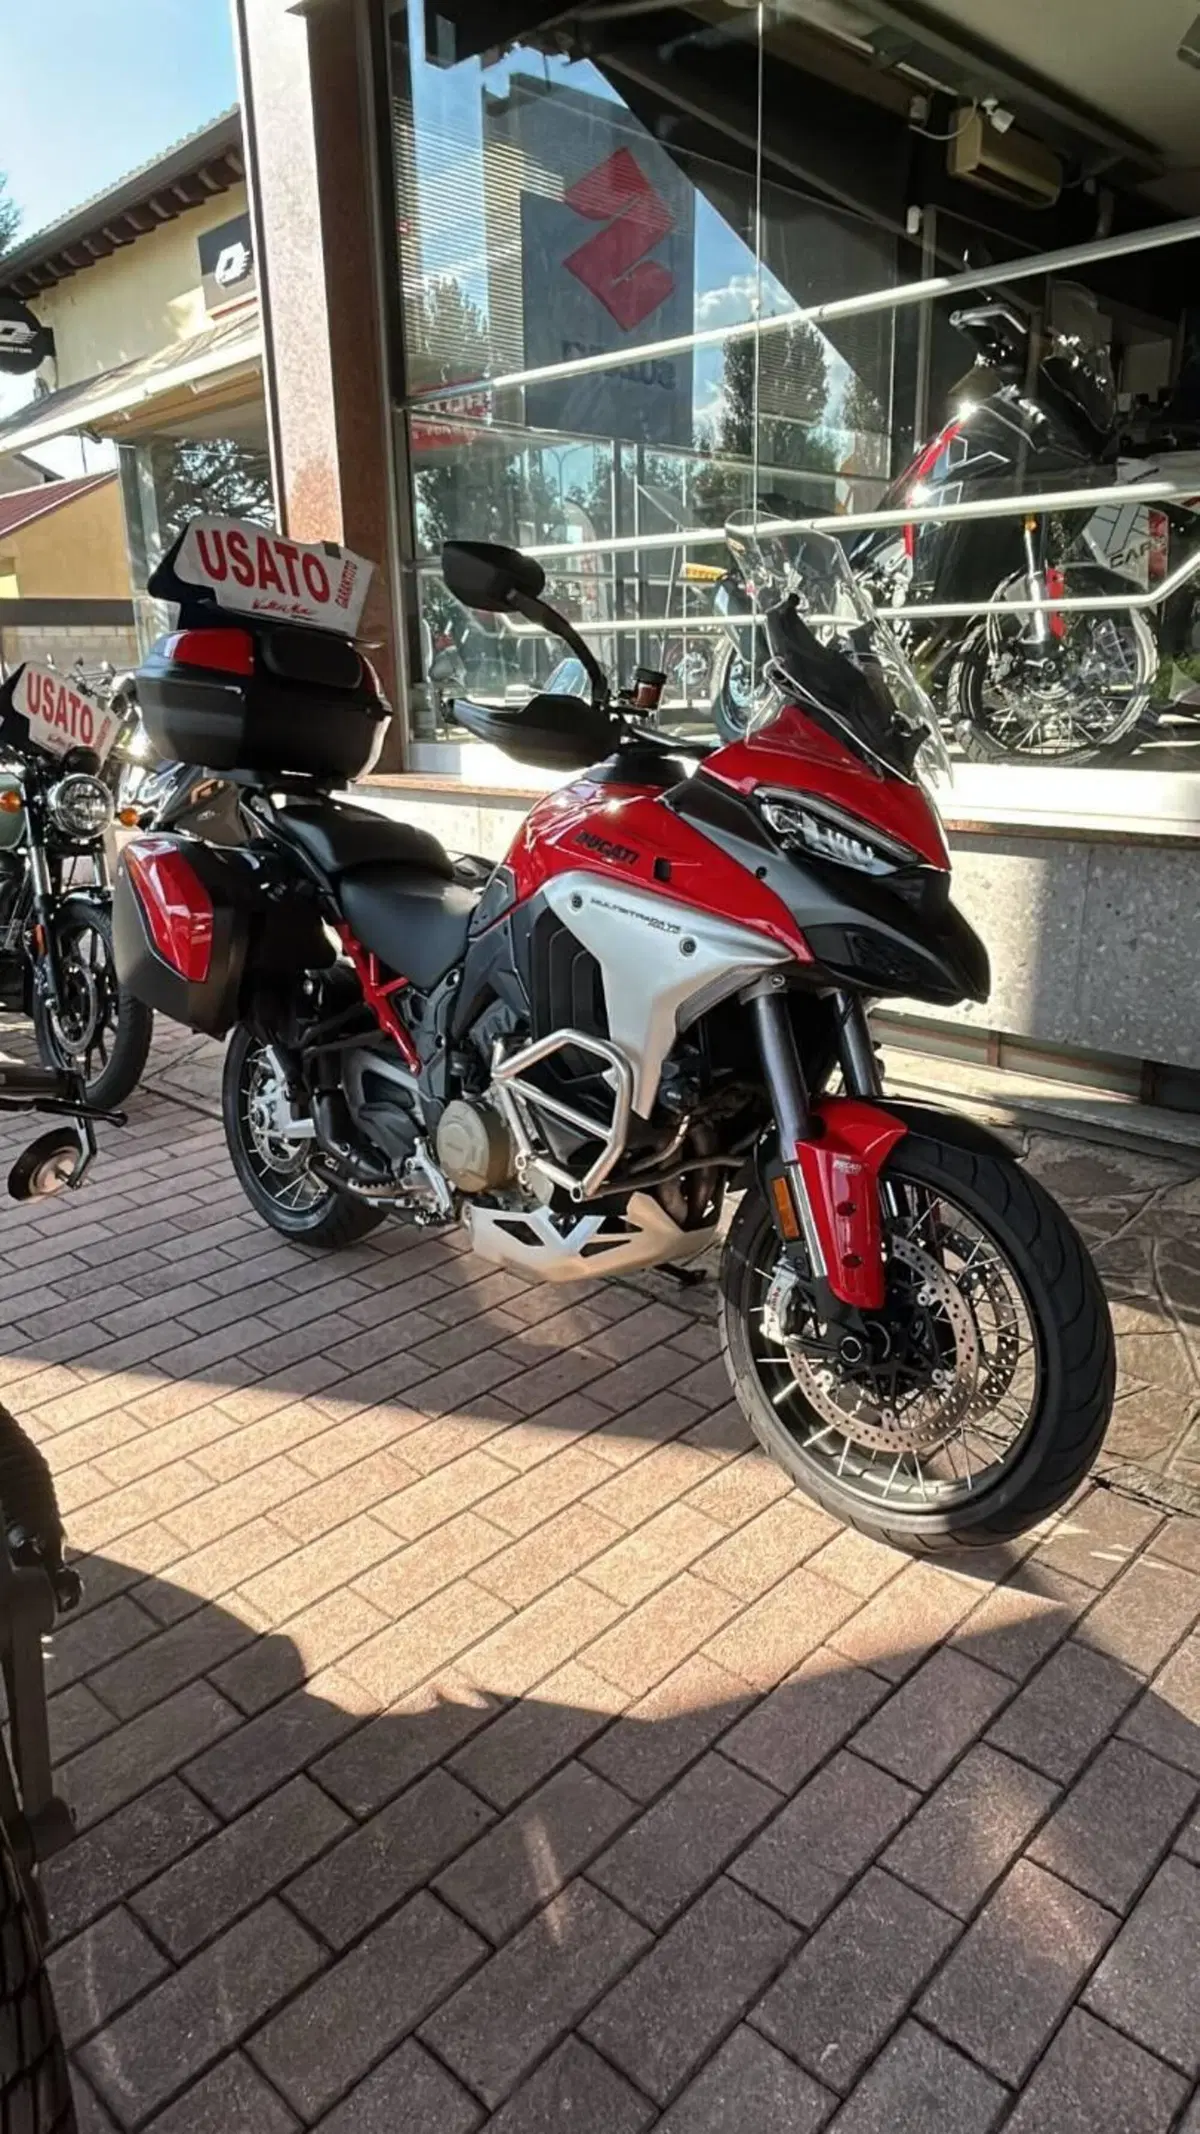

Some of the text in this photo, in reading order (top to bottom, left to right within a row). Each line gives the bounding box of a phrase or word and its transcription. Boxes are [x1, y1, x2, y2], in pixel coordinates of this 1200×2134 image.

[195, 529, 330, 604] USATO
[27, 672, 93, 745] USATO
[575, 831, 639, 865] DUCATI
